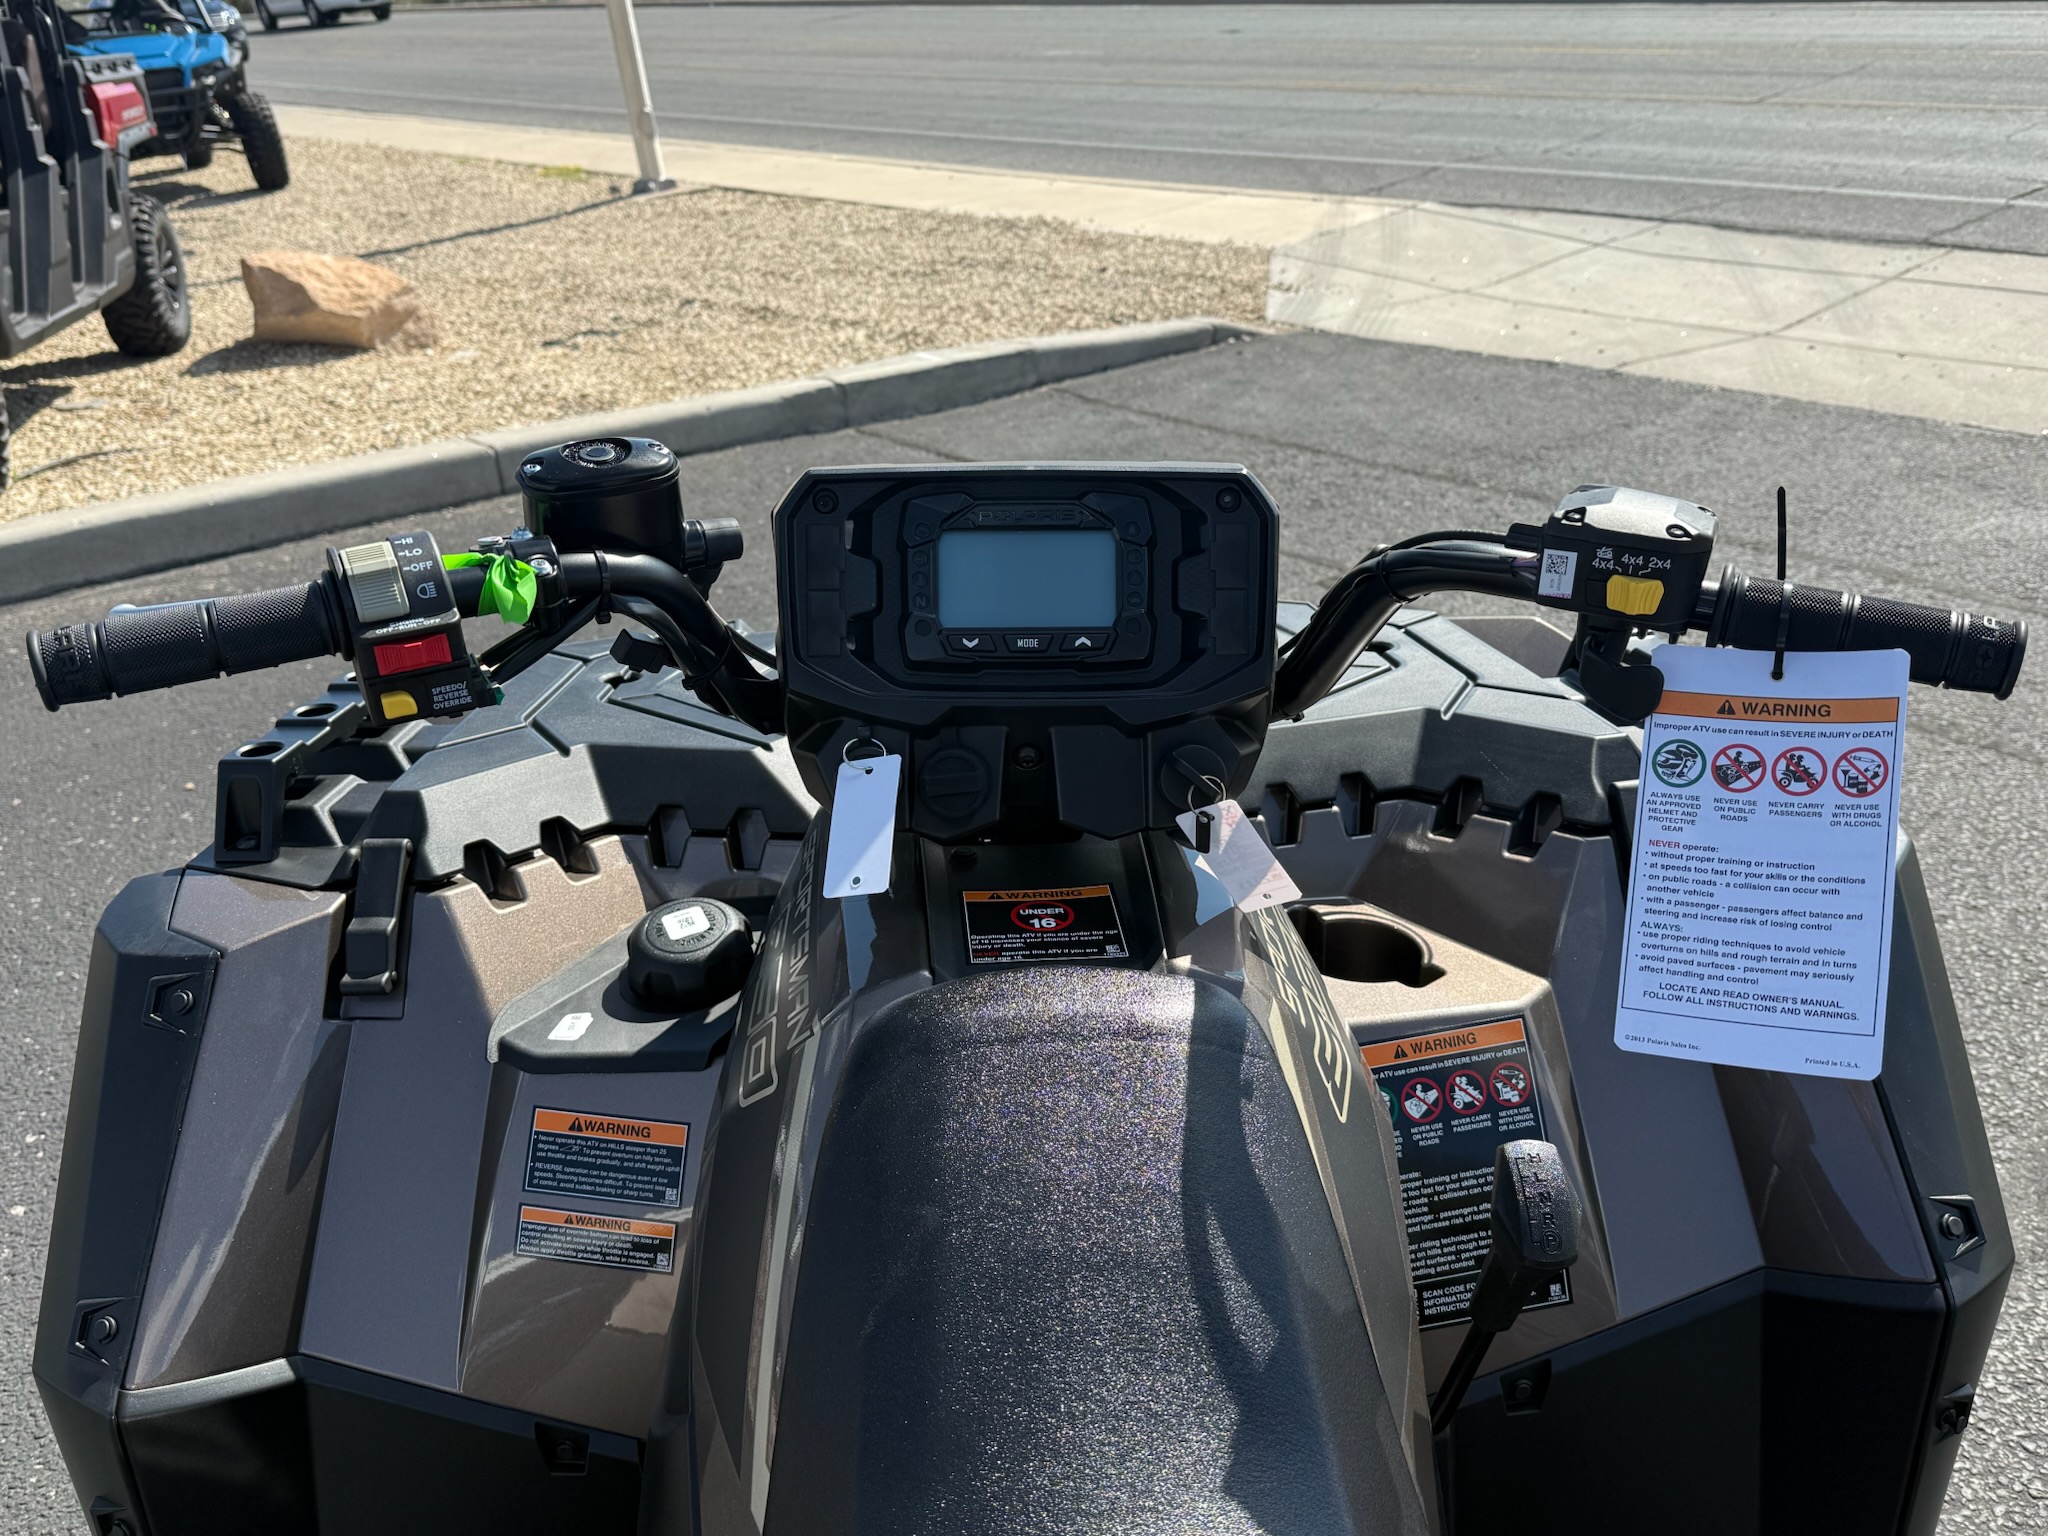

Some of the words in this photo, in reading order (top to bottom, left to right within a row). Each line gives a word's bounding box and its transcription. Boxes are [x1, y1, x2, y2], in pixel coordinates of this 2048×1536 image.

[979, 510, 1076, 521] POLARIS
[1017, 638, 1039, 648] MODE
[434, 689, 469, 702] REVERSE
[433, 696, 472, 710] OVERRIDE
[1742, 702, 1831, 718] WARNING
[1654, 722, 1691, 732] Improper
[1780, 730, 1816, 738] SEVERE
[1658, 800, 1702, 809] APPROVED
[1648, 816, 1696, 825] PROTECTIVE
[1648, 840, 1680, 849] NEVER
[1681, 842, 1719, 854] operate:
[1650, 851, 1683, 860] without
[1685, 855, 1715, 864] proper
[1717, 856, 1752, 867] training
[1766, 860, 1815, 870] instruction
[1004, 890, 1082, 899] WARNING
[1020, 908, 1065, 916] UNDER
[1646, 896, 1664, 904] with
[1673, 900, 1720, 910] passenger
[1727, 904, 1779, 915] passengers
[1781, 907, 1806, 916] affect
[1808, 909, 1844, 918] balance
[1845, 911, 1863, 920] and
[1029, 918, 1057, 928] 16
[1640, 920, 1683, 932] ALWAYS:
[1660, 933, 1691, 943] proper
[1692, 935, 1719, 946] riding
[1720, 937, 1772, 950] techniques
[1785, 943, 1811, 952] avoid
[1812, 945, 1846, 955] vehicle
[1640, 953, 1665, 962] avoid
[1666, 956, 1694, 967] paved
[1696, 959, 1736, 970] surfaces
[1743, 964, 1788, 976] pavement
[1789, 970, 1810, 978] may
[1811, 970, 1855, 982] seriously
[1638, 965, 1664, 974] affect
[1665, 968, 1705, 980] handling
[1706, 972, 1724, 981] and
[1726, 974, 1759, 984] control
[1659, 982, 1698, 994] LOCATE
[1699, 987, 1720, 996] AND
[1722, 989, 1750, 999] READ
[1751, 992, 1798, 1004] OWNER'S
[1799, 997, 1844, 1008] MANUAL.
[1643, 990, 1684, 1002] FOLLOW
[1685, 995, 1704, 1004] ALL
[1706, 997, 1778, 1012] INSTRUCTIONS
[1779, 1005, 1801, 1015] AND
[1802, 1008, 1859, 1021] WARNINGS.
[1410, 1032, 1477, 1055] WARNING
[1498, 1107, 1518, 1116] NEVER
[1498, 1116, 1512, 1124] WITH
[1512, 1112, 1534, 1121] DRUGS
[1450, 1116, 1470, 1126] NEVER
[1470, 1113, 1491, 1122] CARRY
[1453, 1120, 1492, 1132] PASSENGERS
[1508, 1119, 1536, 1129] ALCOHOL
[584, 1120, 651, 1138] WARNING
[1410, 1124, 1430, 1133] NEVER
[1422, 1129, 1444, 1138] PUBLIC
[1418, 1137, 1440, 1146] ROADS
[576, 1215, 631, 1232] WARNING
